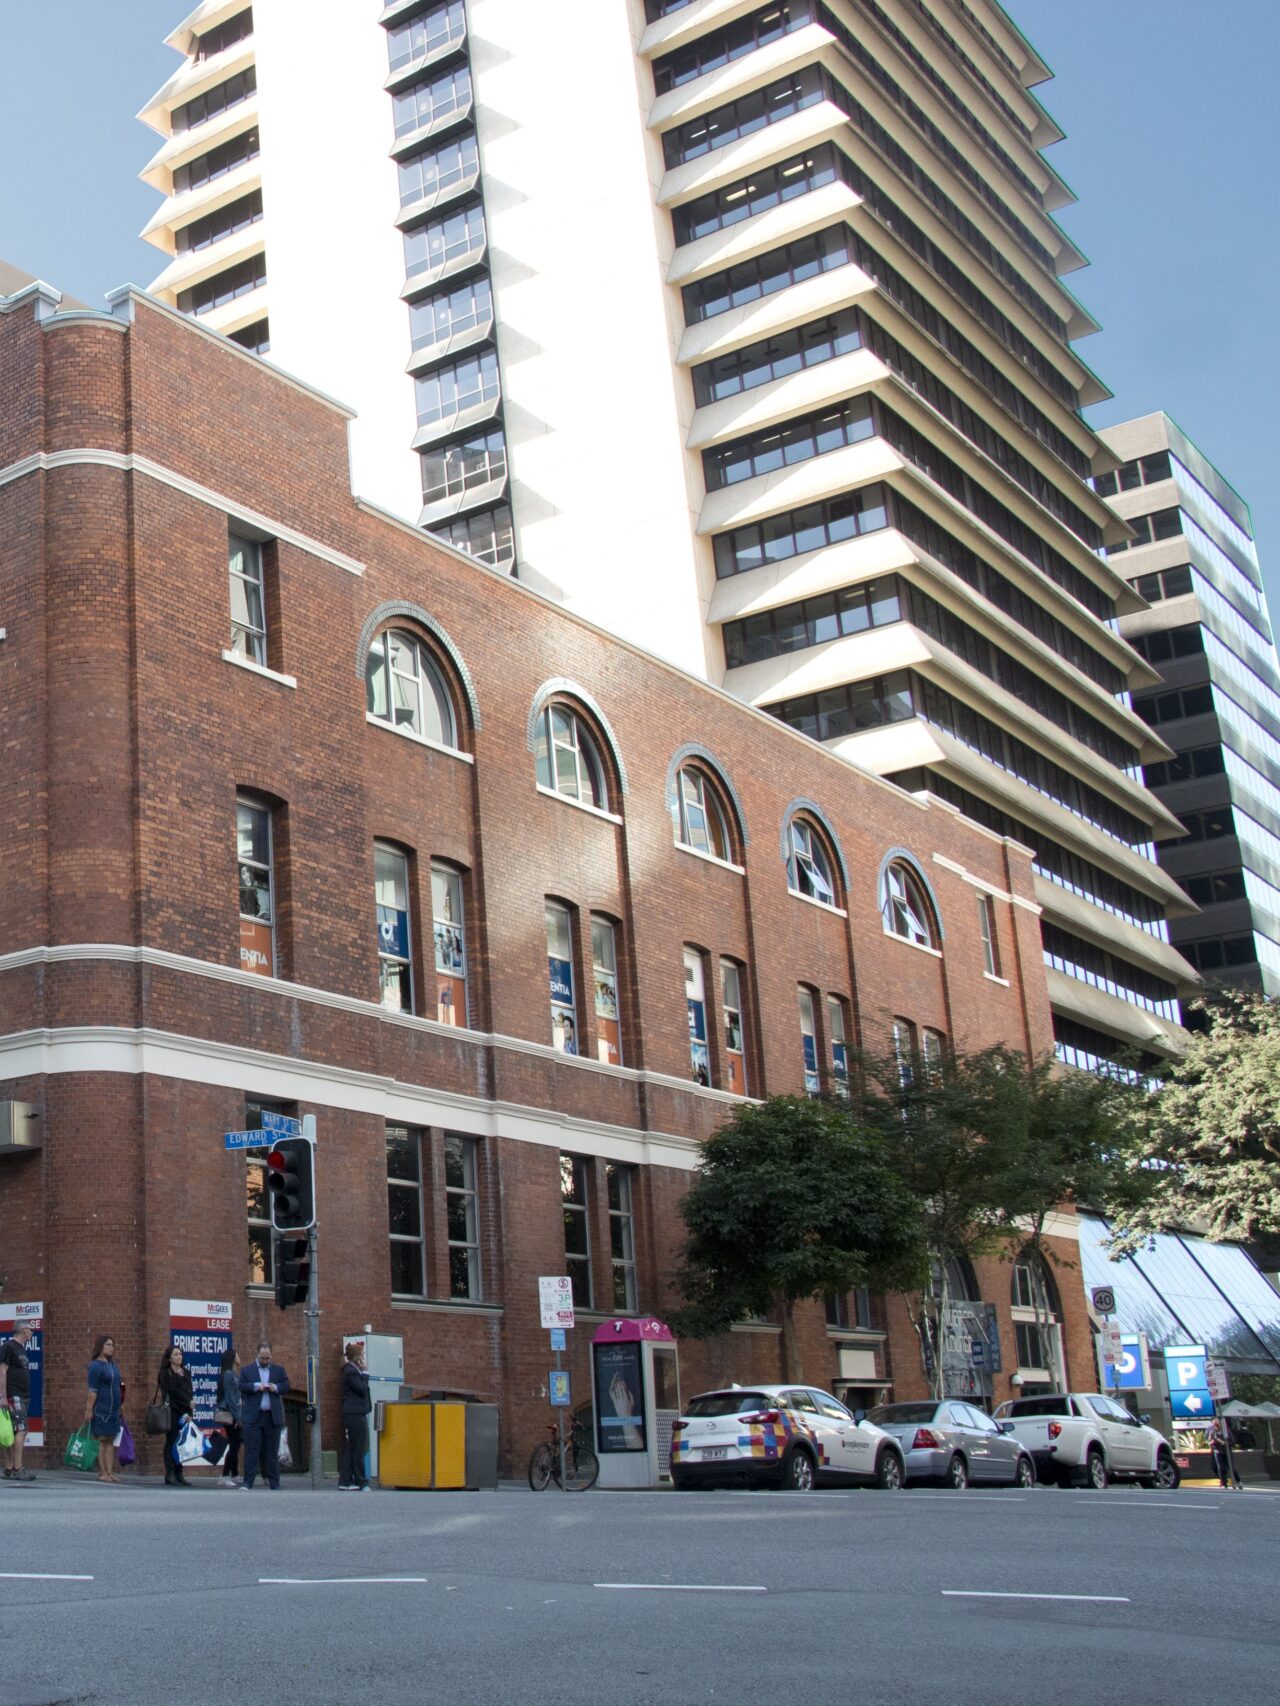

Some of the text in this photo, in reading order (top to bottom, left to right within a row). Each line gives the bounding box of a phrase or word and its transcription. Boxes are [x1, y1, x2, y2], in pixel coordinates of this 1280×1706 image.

[263, 1113, 280, 1124] MARY
[230, 1131, 266, 1144] EDWARD
[1096, 1295, 1112, 1306] 40
[207, 1319, 230, 1330] LEASE
[173, 1335, 200, 1353] PRIME
[191, 1363, 208, 1376] ground
[1177, 1361, 1198, 1386] P
[200, 1379, 218, 1392] Ceilings
[193, 1395, 205, 1405] tural
[193, 1408, 214, 1422] Exposure
